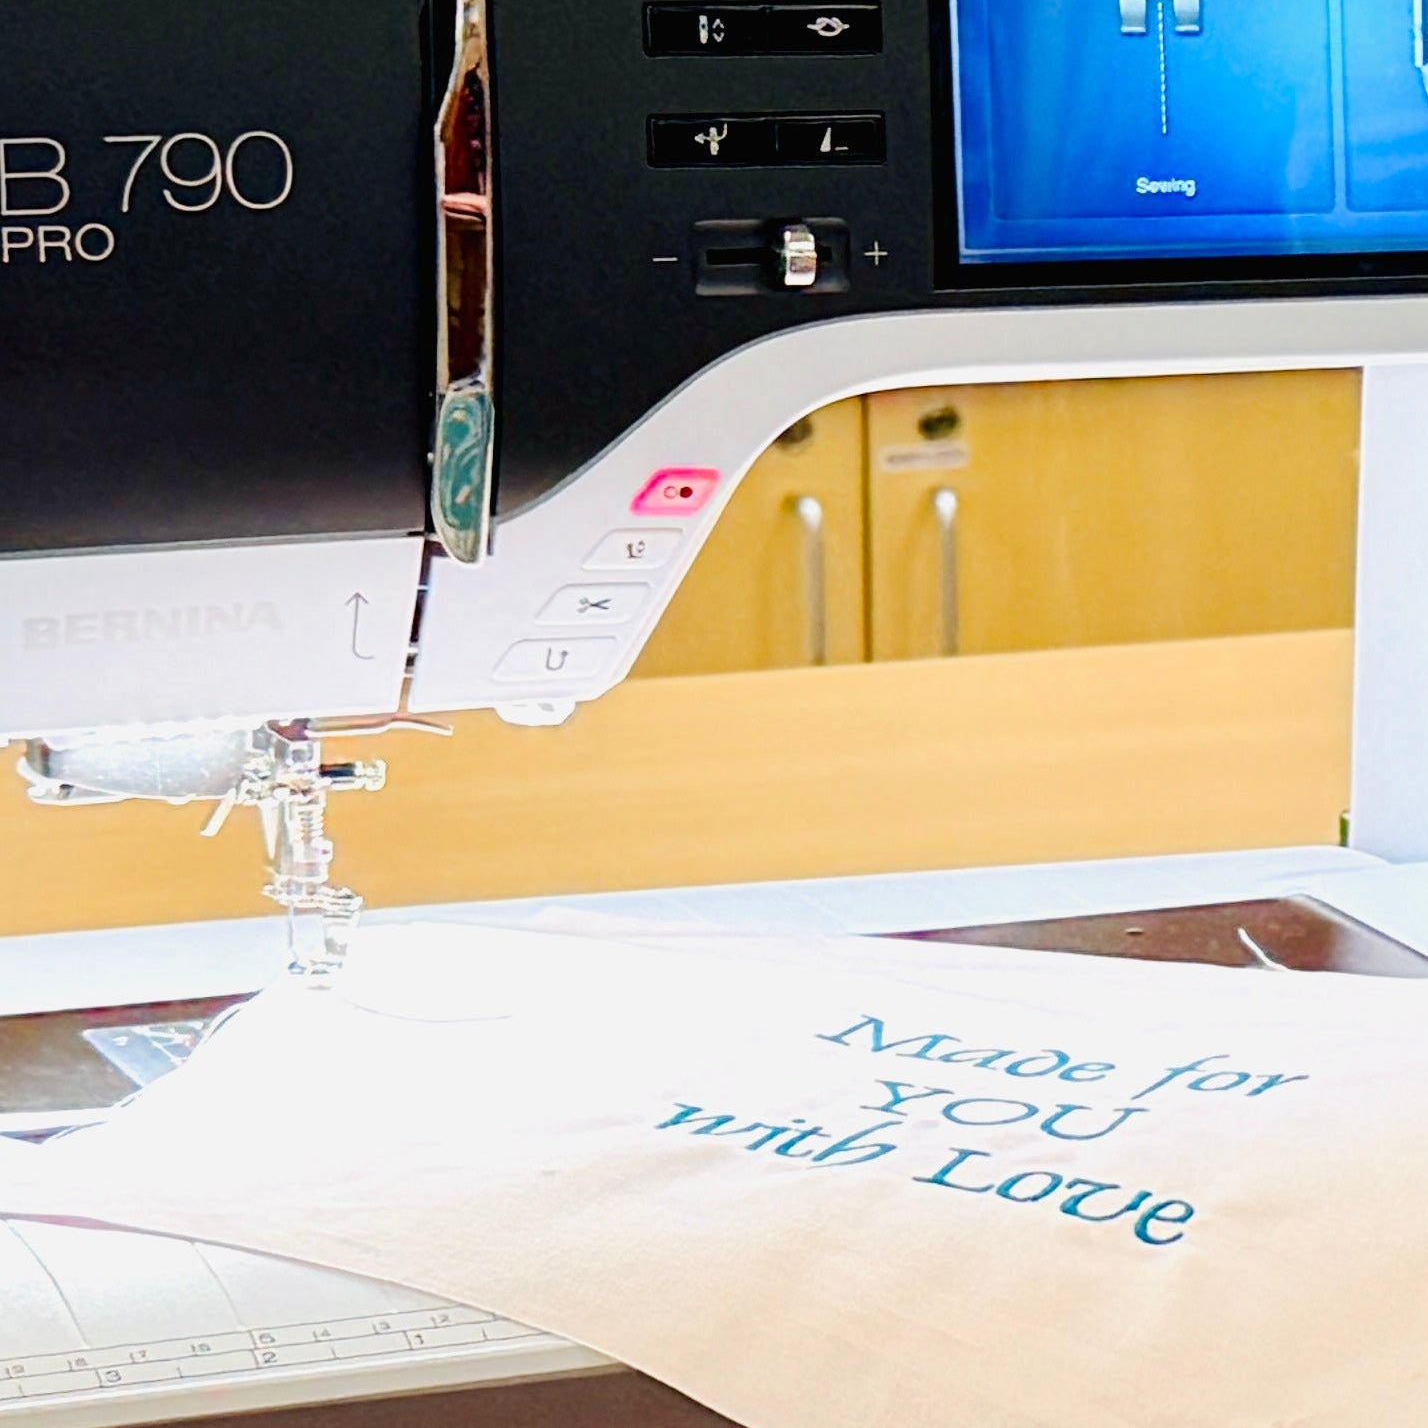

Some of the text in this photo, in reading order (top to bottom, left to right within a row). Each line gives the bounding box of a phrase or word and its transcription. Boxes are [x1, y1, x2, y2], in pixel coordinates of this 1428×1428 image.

[0, 130, 294, 216] B 790
[1136, 176, 1197, 197] Sewing
[1, 222, 116, 263] PRO
[21, 599, 285, 651] BERNINA
[814, 1013, 1310, 1101] Made for
[858, 1078, 1151, 1141] YOU
[652, 1101, 1196, 1246] with Love
